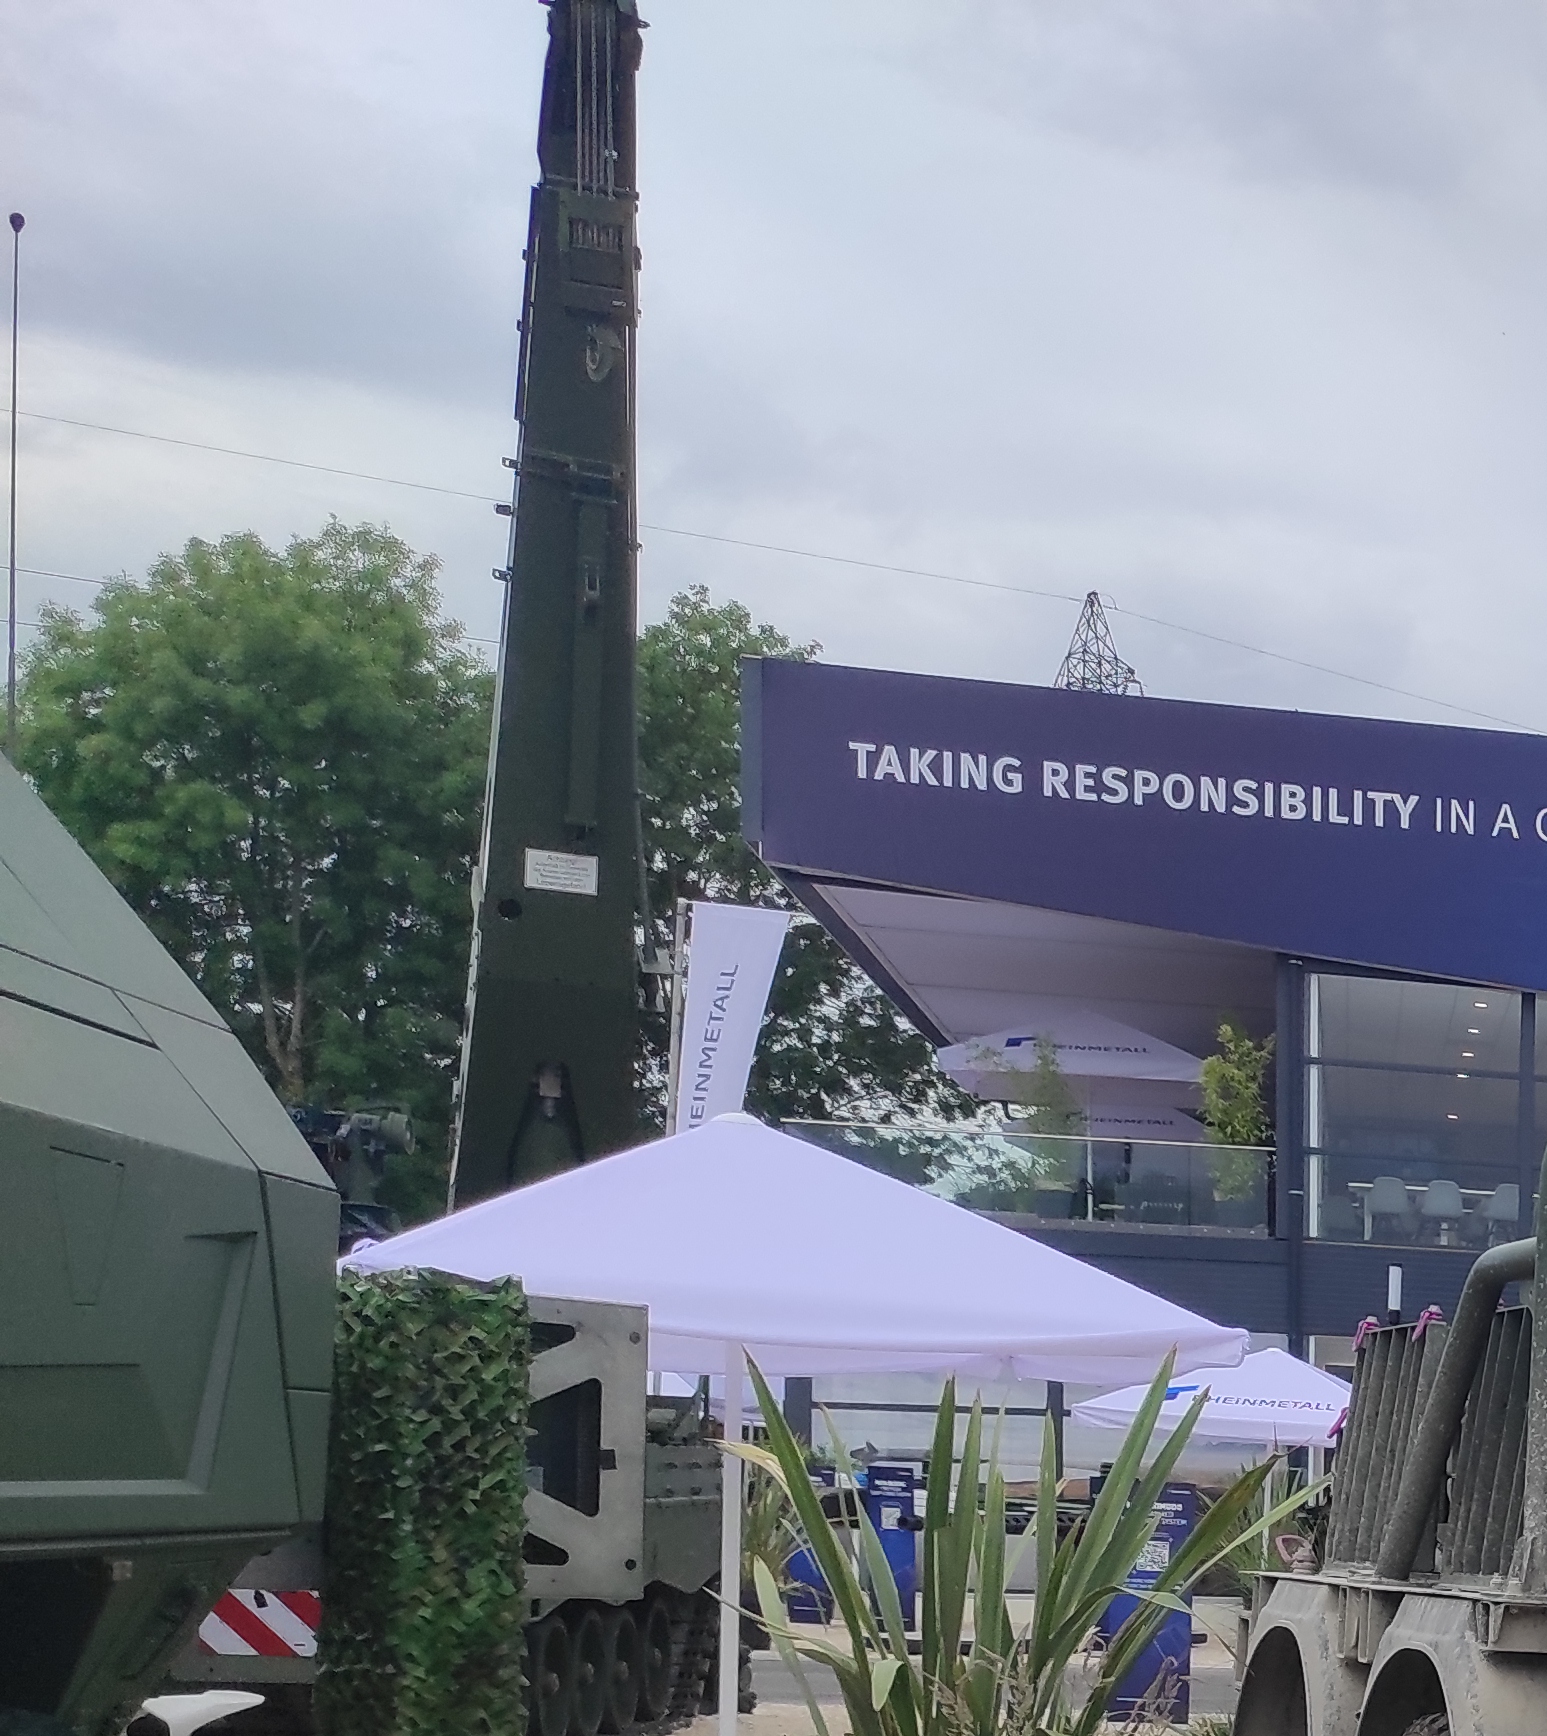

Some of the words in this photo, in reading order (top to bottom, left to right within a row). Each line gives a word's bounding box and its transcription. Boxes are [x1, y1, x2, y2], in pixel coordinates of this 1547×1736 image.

[848, 741, 1023, 793] TAKING
[1043, 760, 1419, 829] RESPONSIBILITY
[1435, 797, 1476, 835] IN
[1492, 803, 1520, 839] A
[688, 963, 740, 1129] EINMETALL
